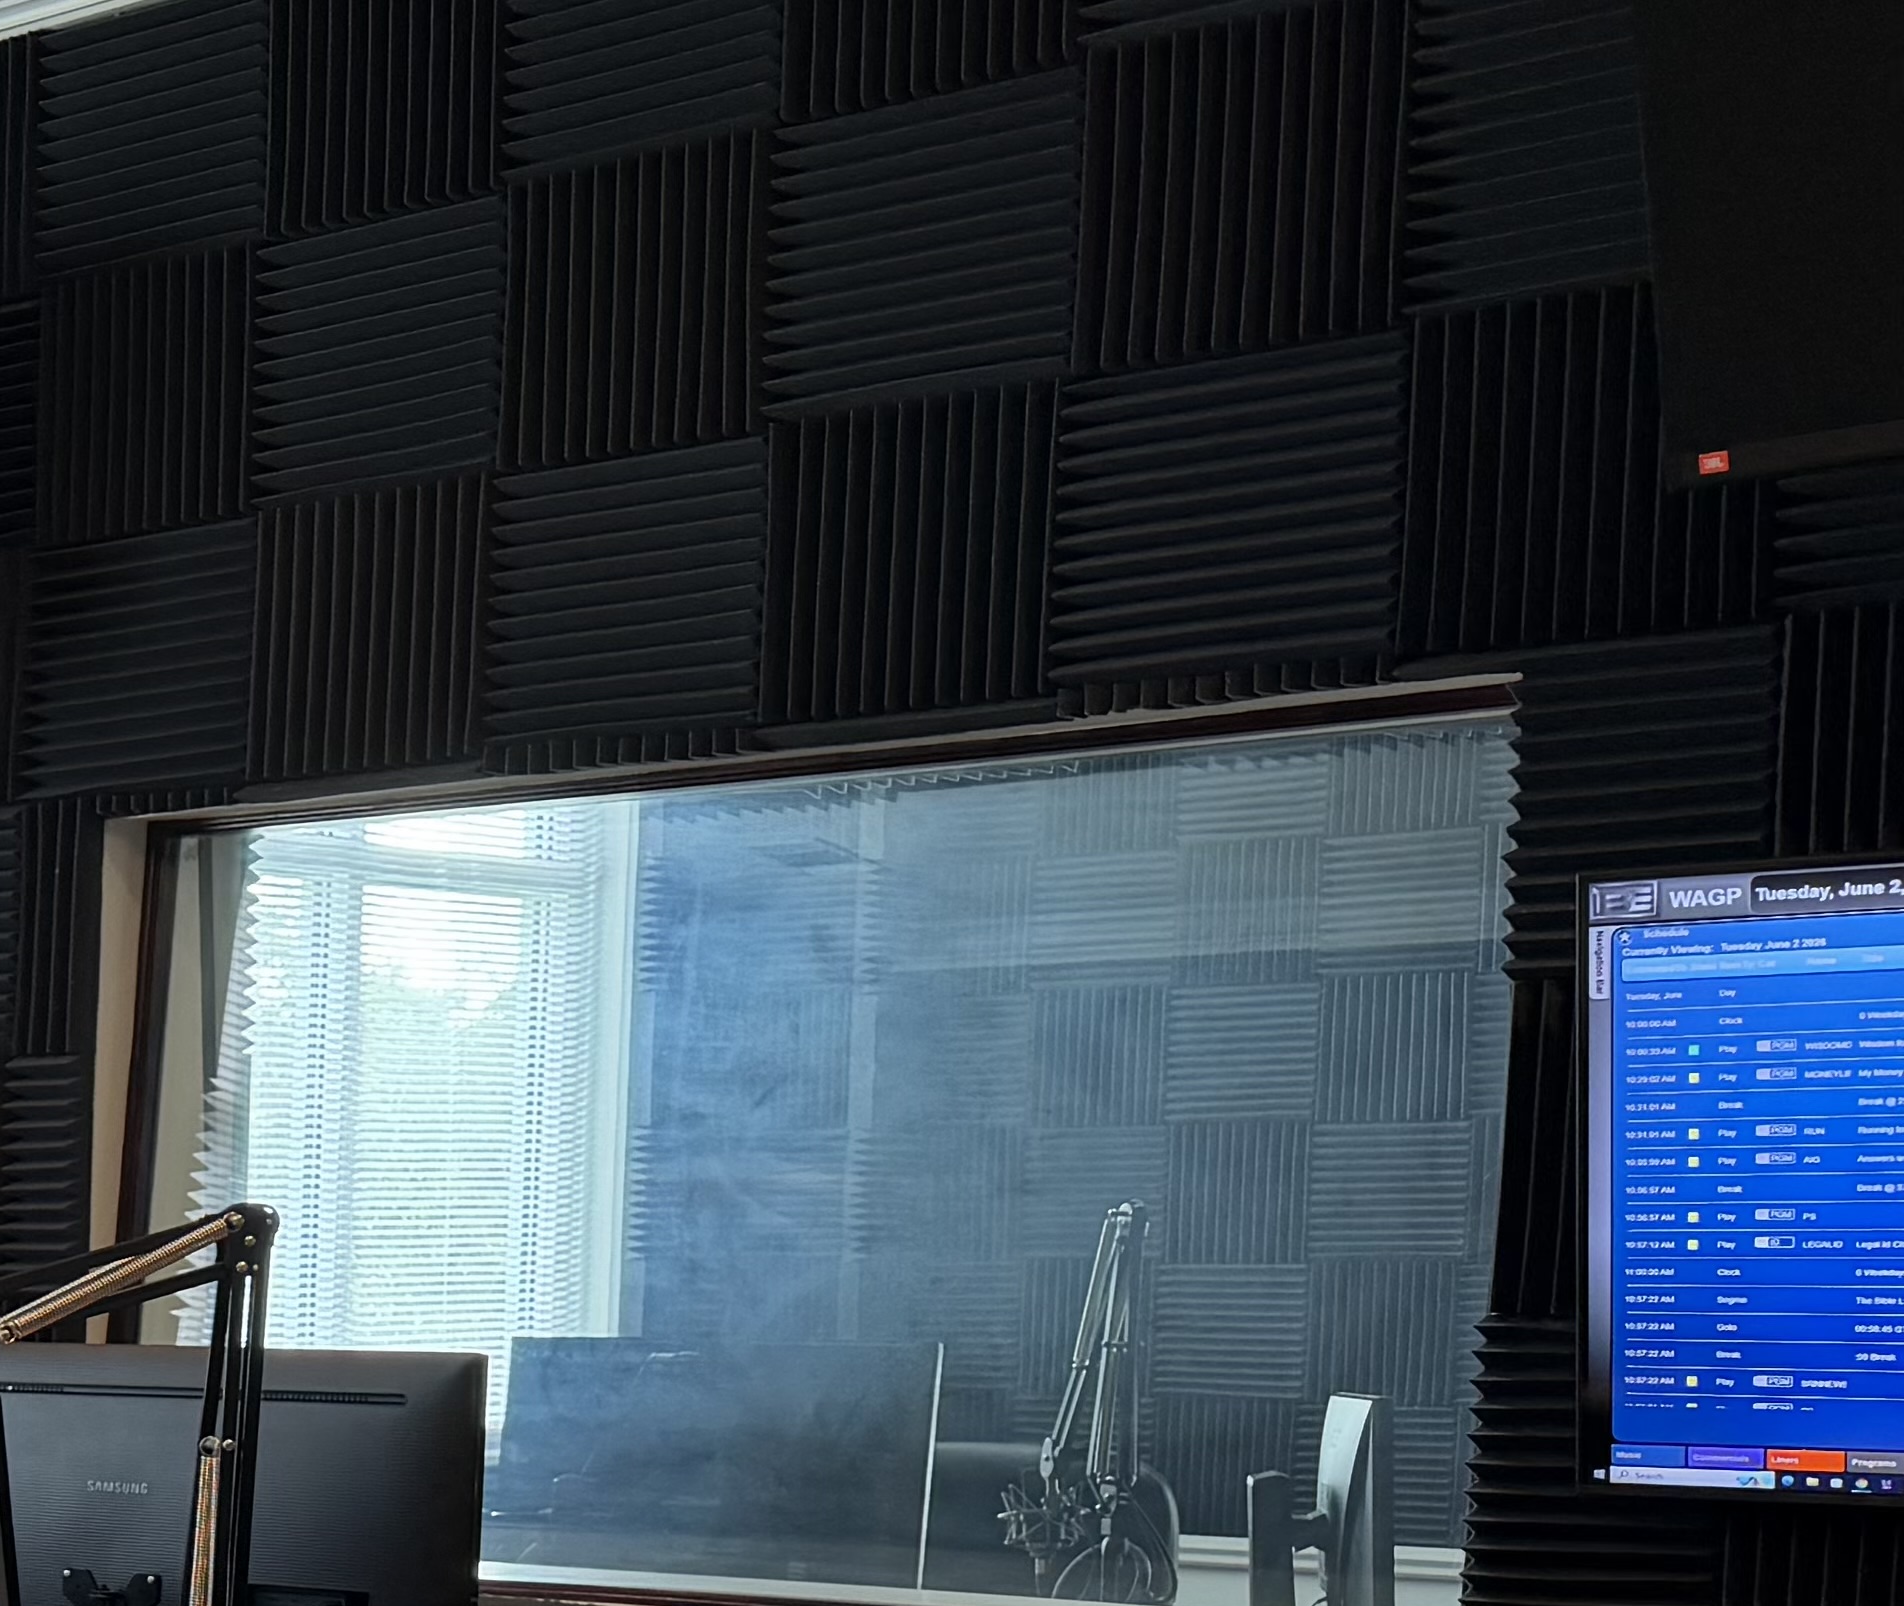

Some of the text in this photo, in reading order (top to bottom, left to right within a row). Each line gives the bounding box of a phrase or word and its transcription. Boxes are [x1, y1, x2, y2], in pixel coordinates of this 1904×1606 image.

[1669, 887, 1743, 909] WAGP
[1755, 886, 1834, 902] Tuesday,
[1838, 881, 1885, 897] June
[86, 1479, 148, 1495] SAMSUNG
